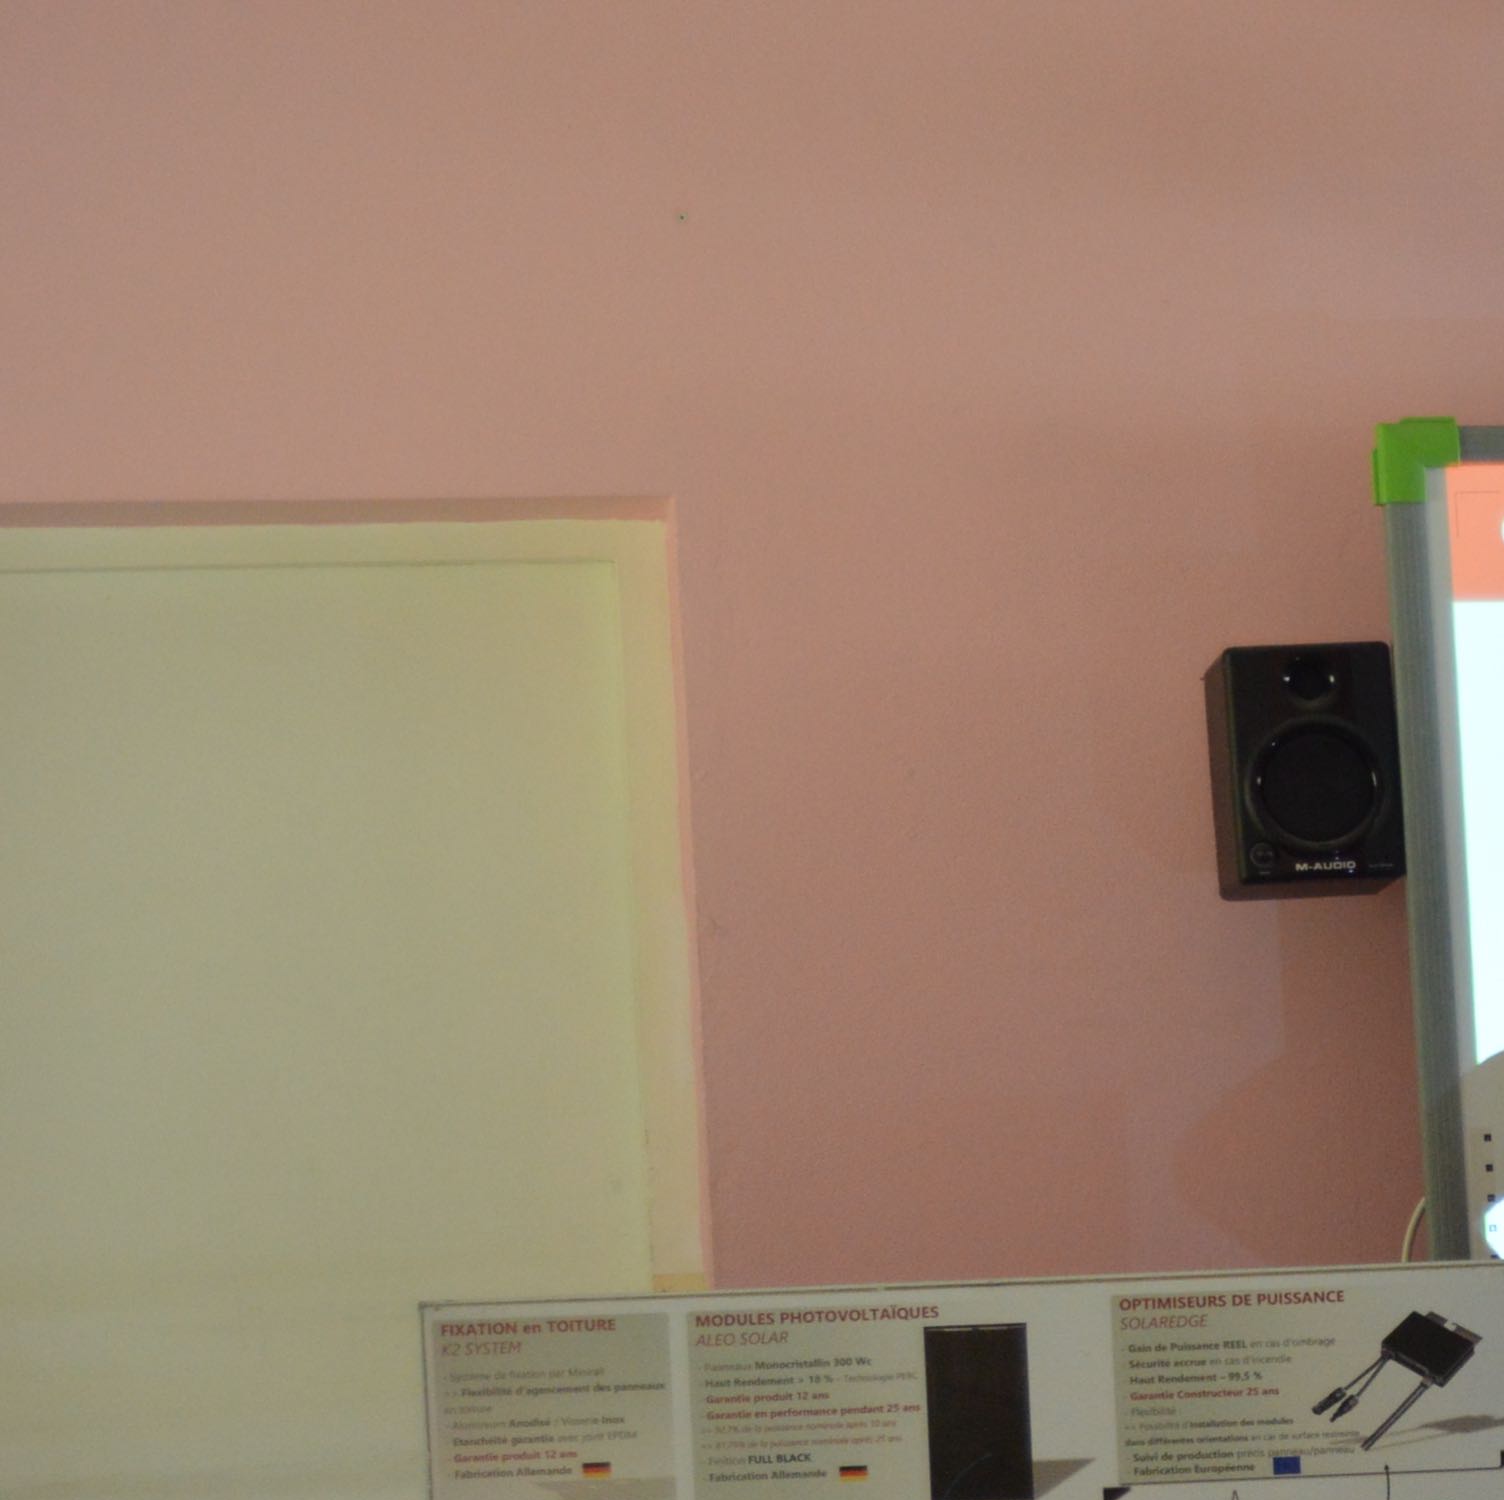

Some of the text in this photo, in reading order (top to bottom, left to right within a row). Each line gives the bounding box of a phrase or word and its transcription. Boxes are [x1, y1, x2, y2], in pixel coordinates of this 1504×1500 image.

[1296, 860, 1356, 872] M-AUDIO
[1119, 1290, 1345, 1312] OPTIMISEURS DE PUISSANCE
[695, 1304, 939, 1327] MODULES PHOTOVOLTAÏQUES
[1120, 1314, 1209, 1330] SOLAREDGE
[441, 1319, 616, 1337] FIXATION en TOITURE
[695, 1330, 789, 1347] ALEO SOLAR
[1223, 1339, 1246, 1349] REEL
[441, 1341, 522, 1357] K2 SYSTEM
[1158, 1373, 1217, 1384] Rendement
[1130, 1391, 1175, 1402] Garantie
[1177, 1389, 1243, 1399] Constructeur
[748, 1453, 812, 1465] FULL BLACK
